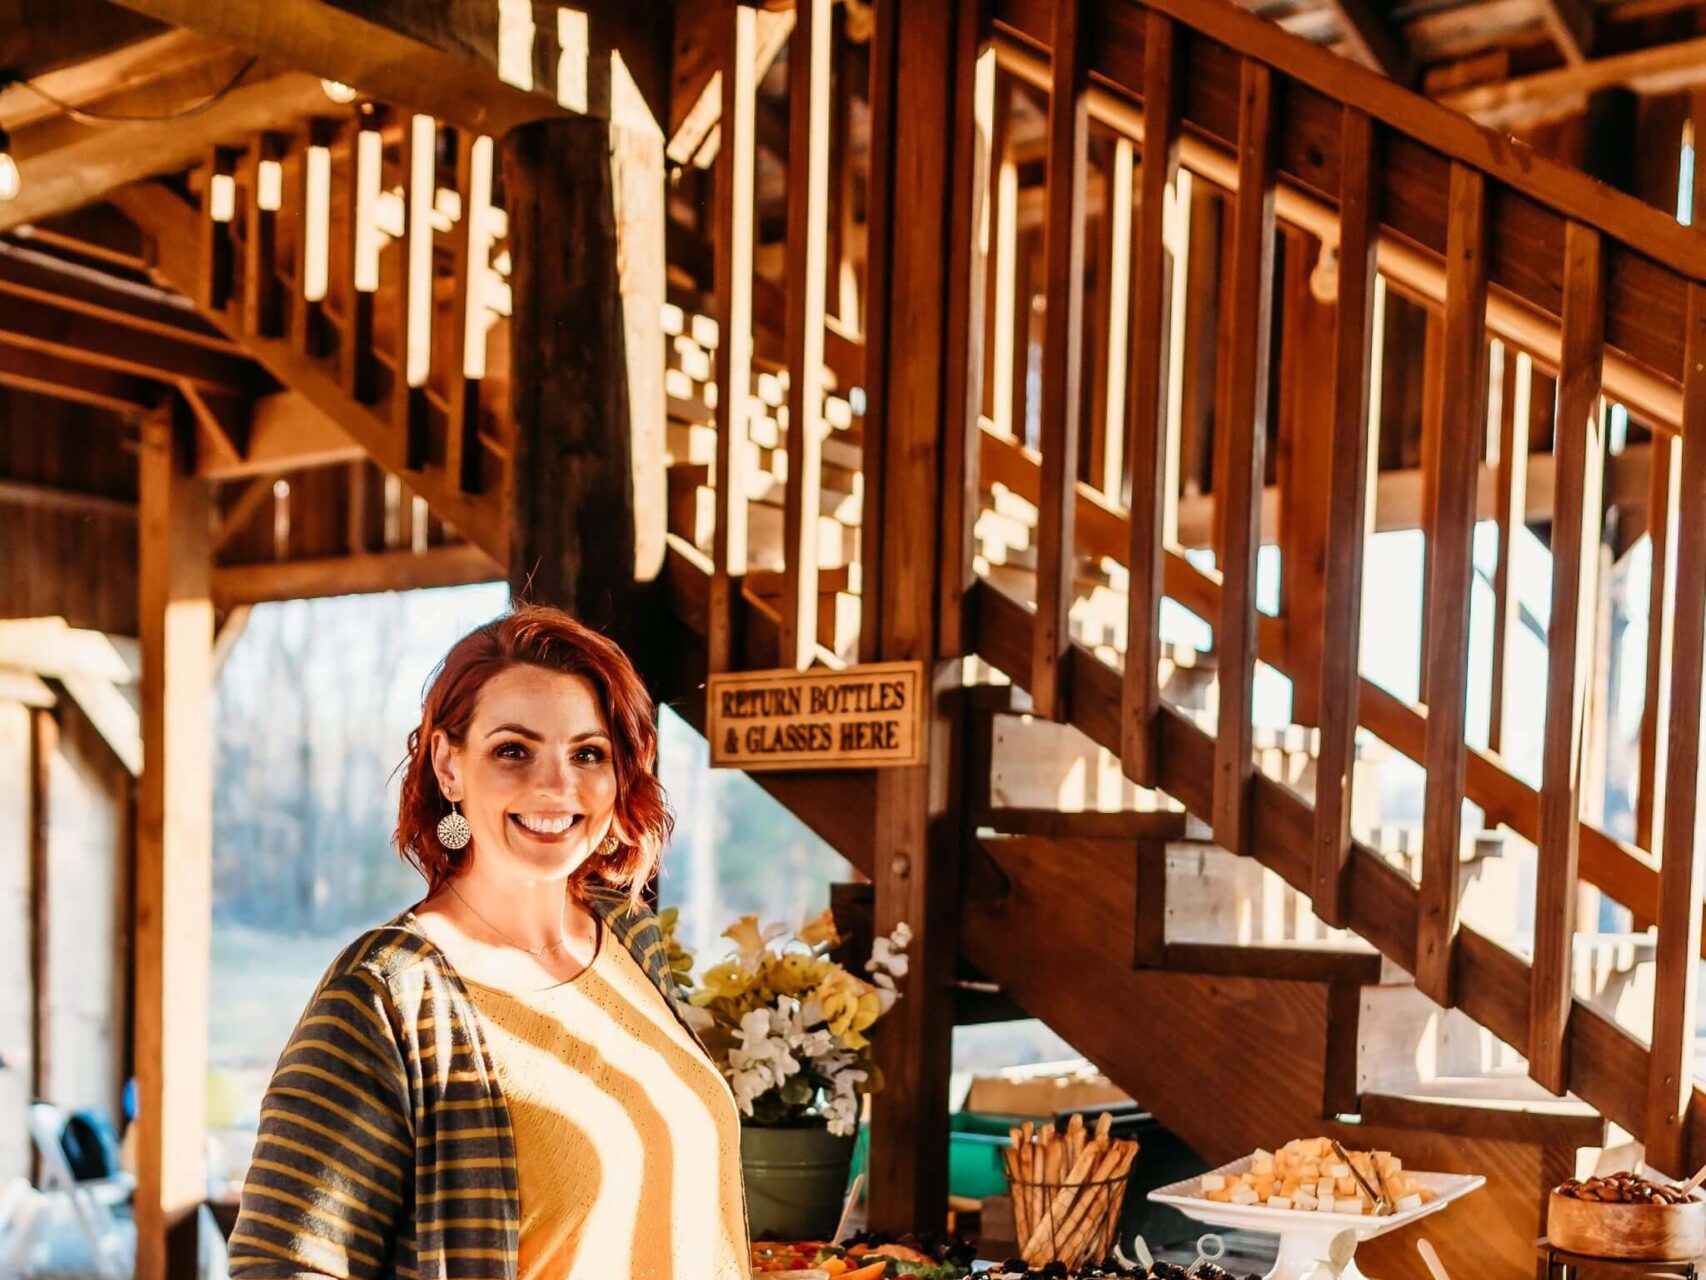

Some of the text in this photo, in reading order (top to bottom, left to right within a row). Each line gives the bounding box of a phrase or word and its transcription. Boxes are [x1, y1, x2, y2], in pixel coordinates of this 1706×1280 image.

[721, 681, 905, 718] RETURN BOTTLES
[724, 720, 900, 754] & GLASSES HERE
